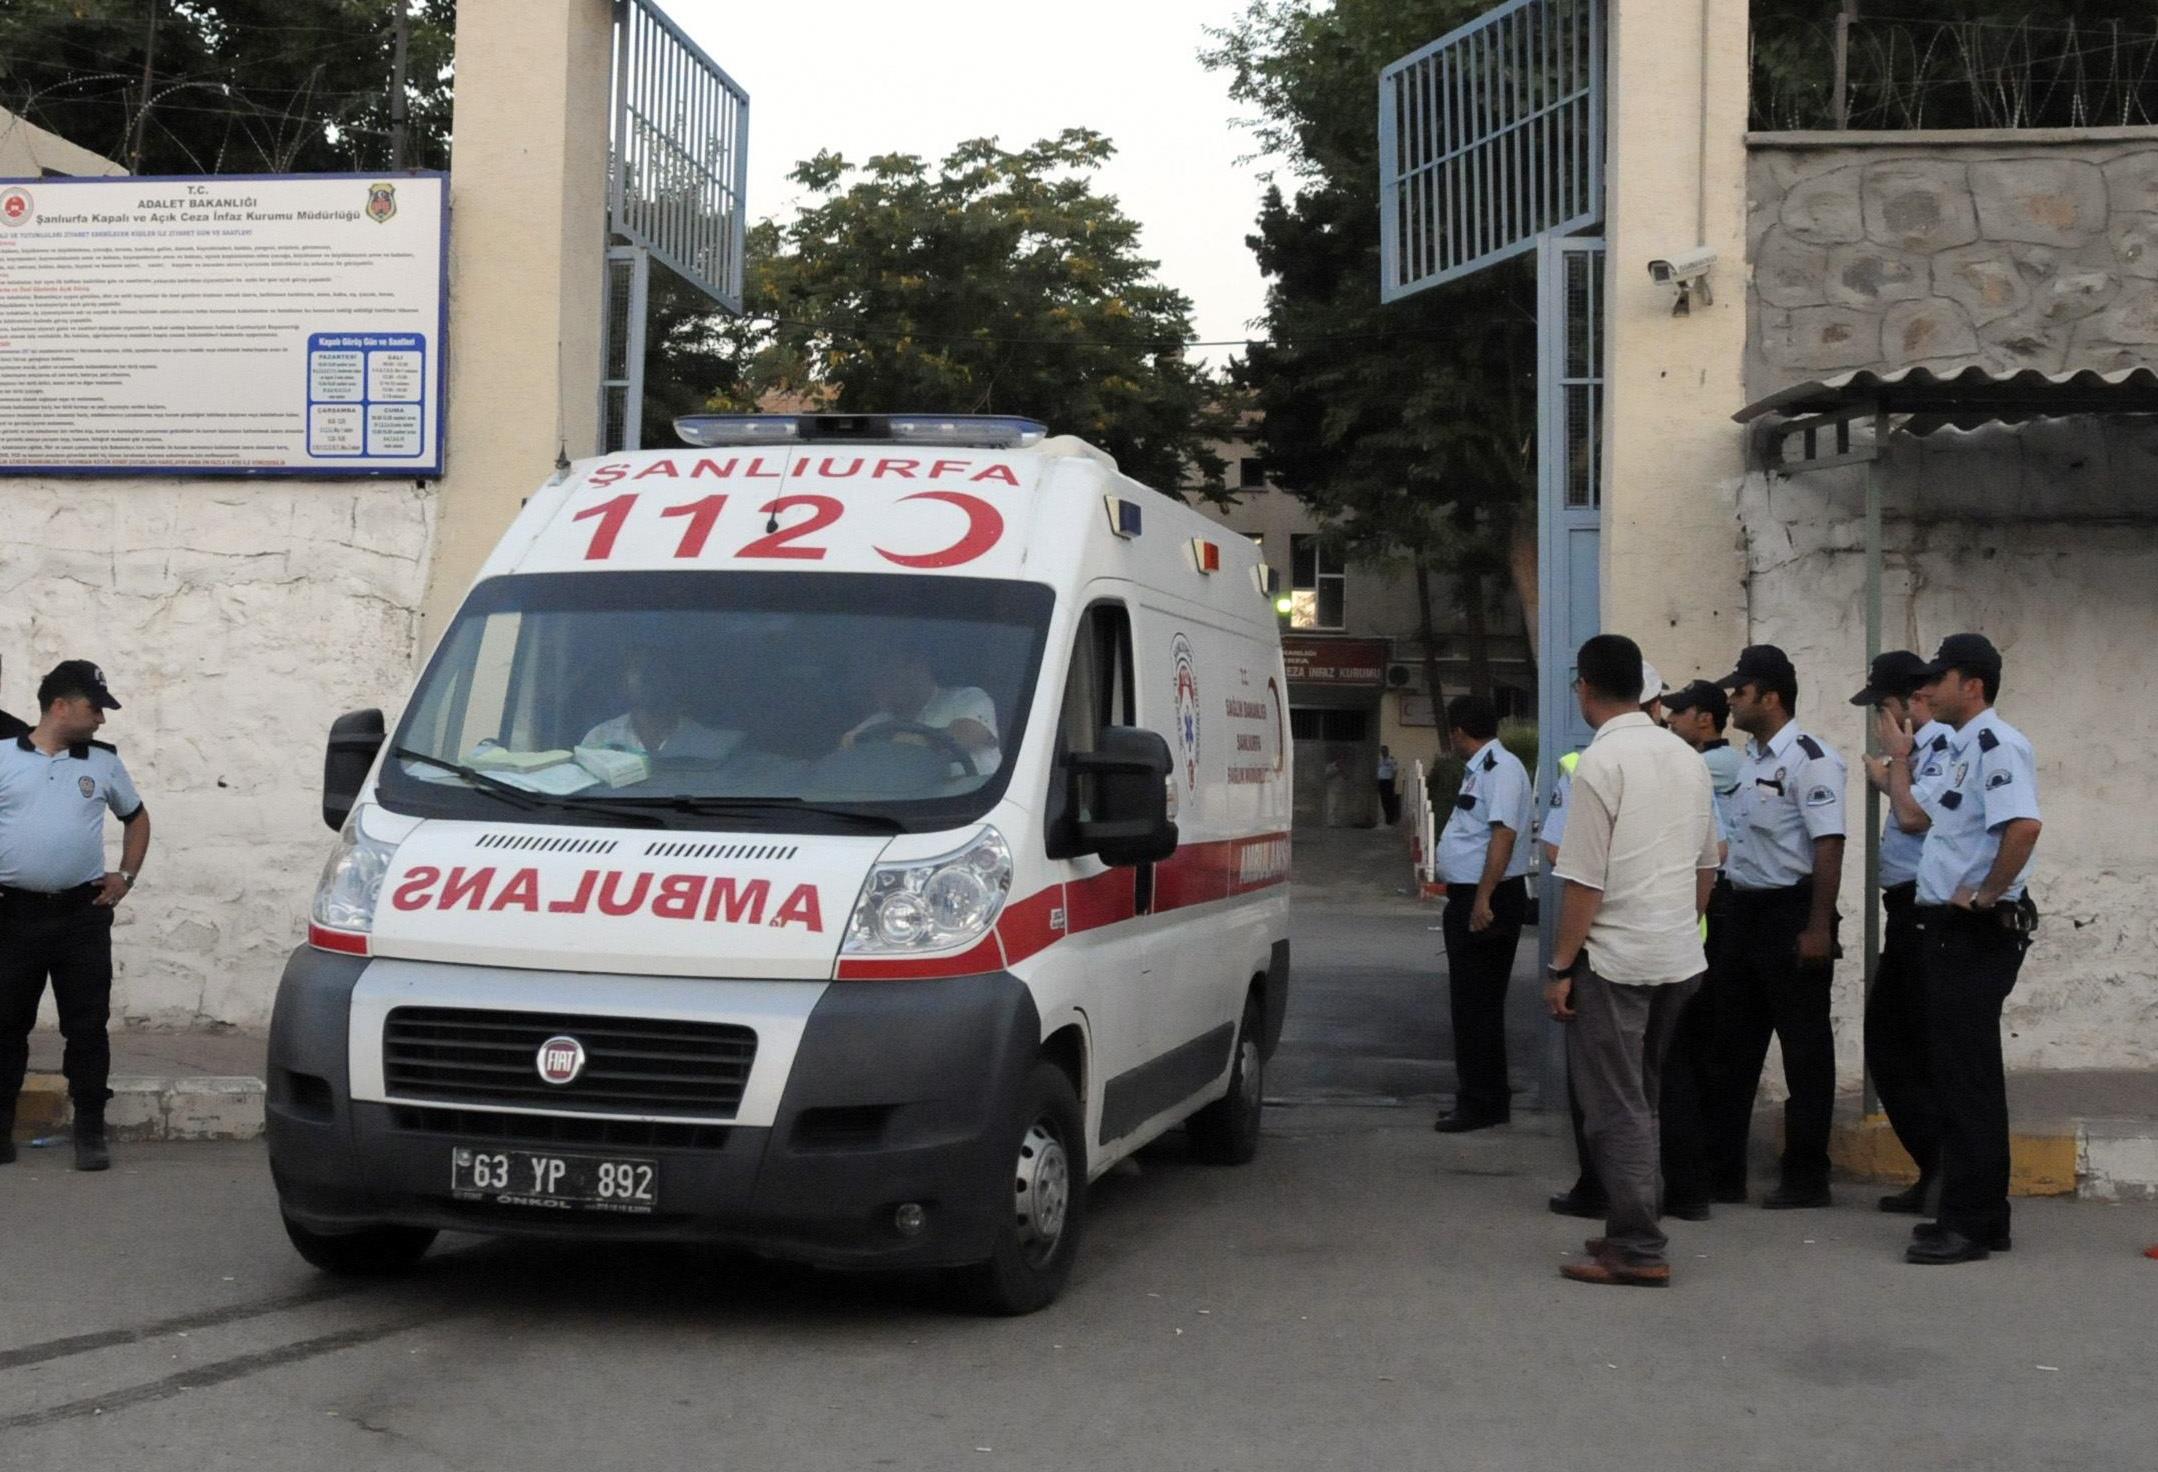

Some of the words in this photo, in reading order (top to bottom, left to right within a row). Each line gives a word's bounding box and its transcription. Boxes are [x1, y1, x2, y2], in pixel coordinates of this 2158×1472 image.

[187, 186, 209, 195] T.C.
[138, 199, 185, 209] ADALET
[189, 196, 257, 208] BAKANLIĞI
[92, 213, 129, 224] Kapalı
[133, 215, 147, 223] ve
[151, 213, 177, 224] Açık
[180, 212, 209, 222] Ceza
[214, 211, 243, 221] İnfaz
[246, 211, 293, 221] Kurumu
[297, 210, 361, 222] Müdürlüğü
[588, 457, 1021, 489] ŞANLIURFA
[572, 493, 845, 561] 112
[547, 1049, 576, 1072] FIAT
[473, 1153, 510, 1189] 63
[531, 1157, 567, 1194] YP
[597, 1162, 654, 1200] 892
